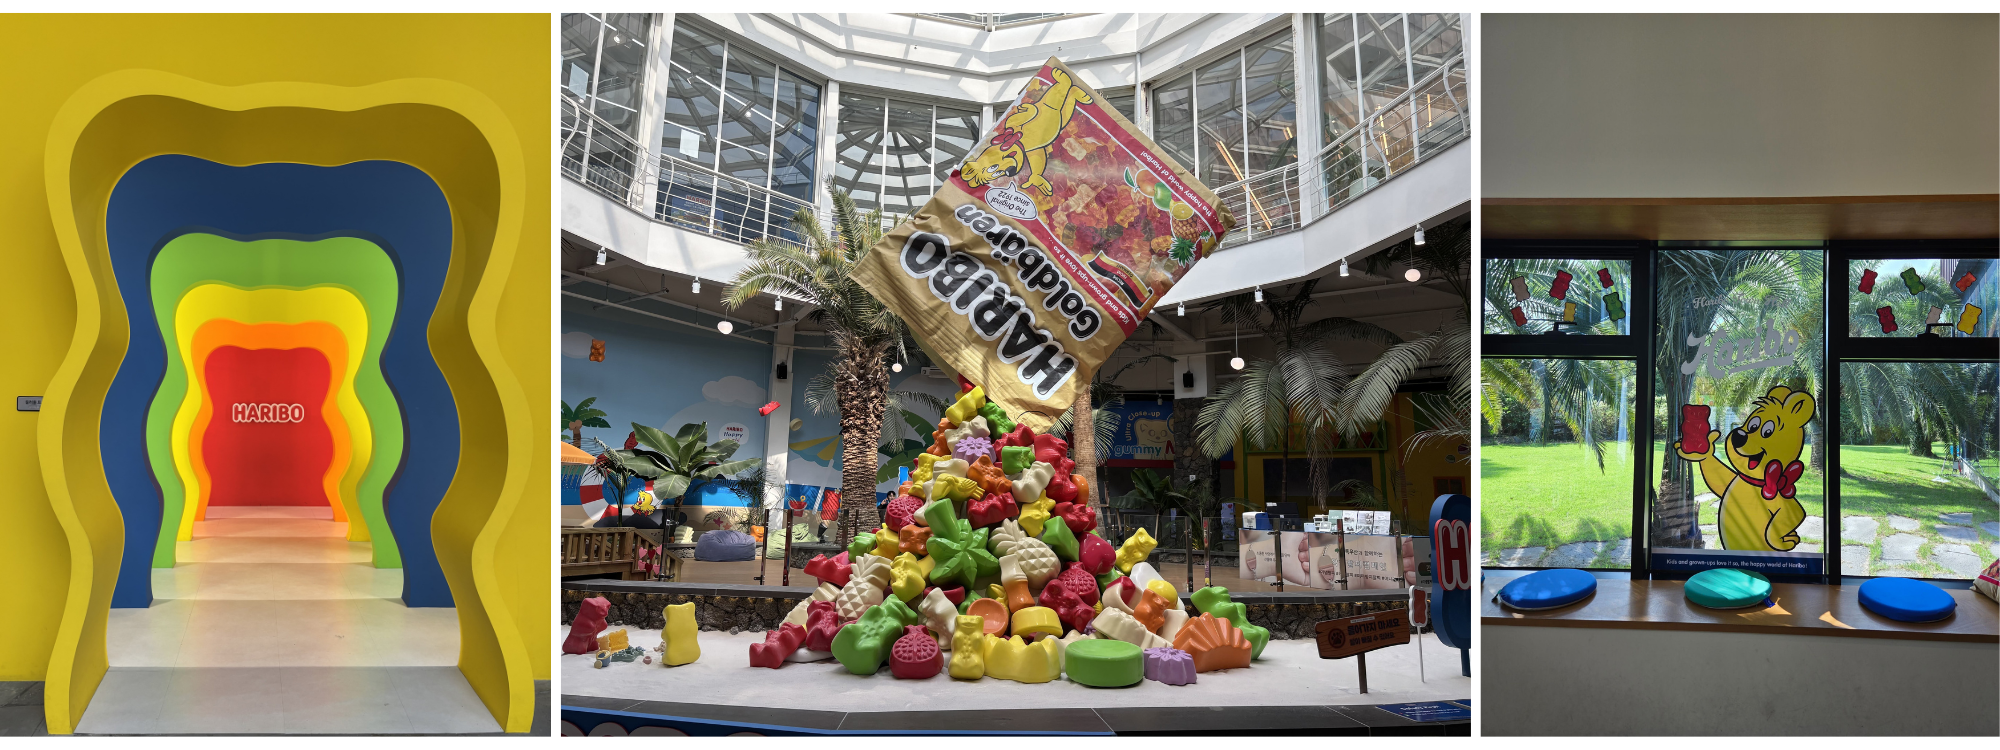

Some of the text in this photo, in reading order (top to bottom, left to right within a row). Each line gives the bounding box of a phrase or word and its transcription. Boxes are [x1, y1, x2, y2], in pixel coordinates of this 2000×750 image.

[1140, 151, 1162, 170] Haribo!
[1168, 175, 1184, 191] world
[990, 197, 1026, 216] The Original
[998, 191, 1030, 206] since 1922
[1184, 190, 1202, 208] happy
[1202, 206, 1212, 216] the
[1053, 246, 1060, 254] so
[955, 204, 1102, 341] Goldbären
[1065, 259, 1078, 272] love
[1077, 271, 1107, 300] grown-ups
[1106, 300, 1118, 311] and
[901, 231, 1078, 400] HARIBO
[1119, 310, 1130, 324] Kids
[1681, 318, 1799, 380] Haribo
[232, 403, 305, 423] HARIBO
[1127, 411, 1160, 420] Close-up
[1113, 445, 1161, 457] gummy
[1347, 622, 1376, 636] 들어가지
[1378, 618, 1401, 631] 마세요
